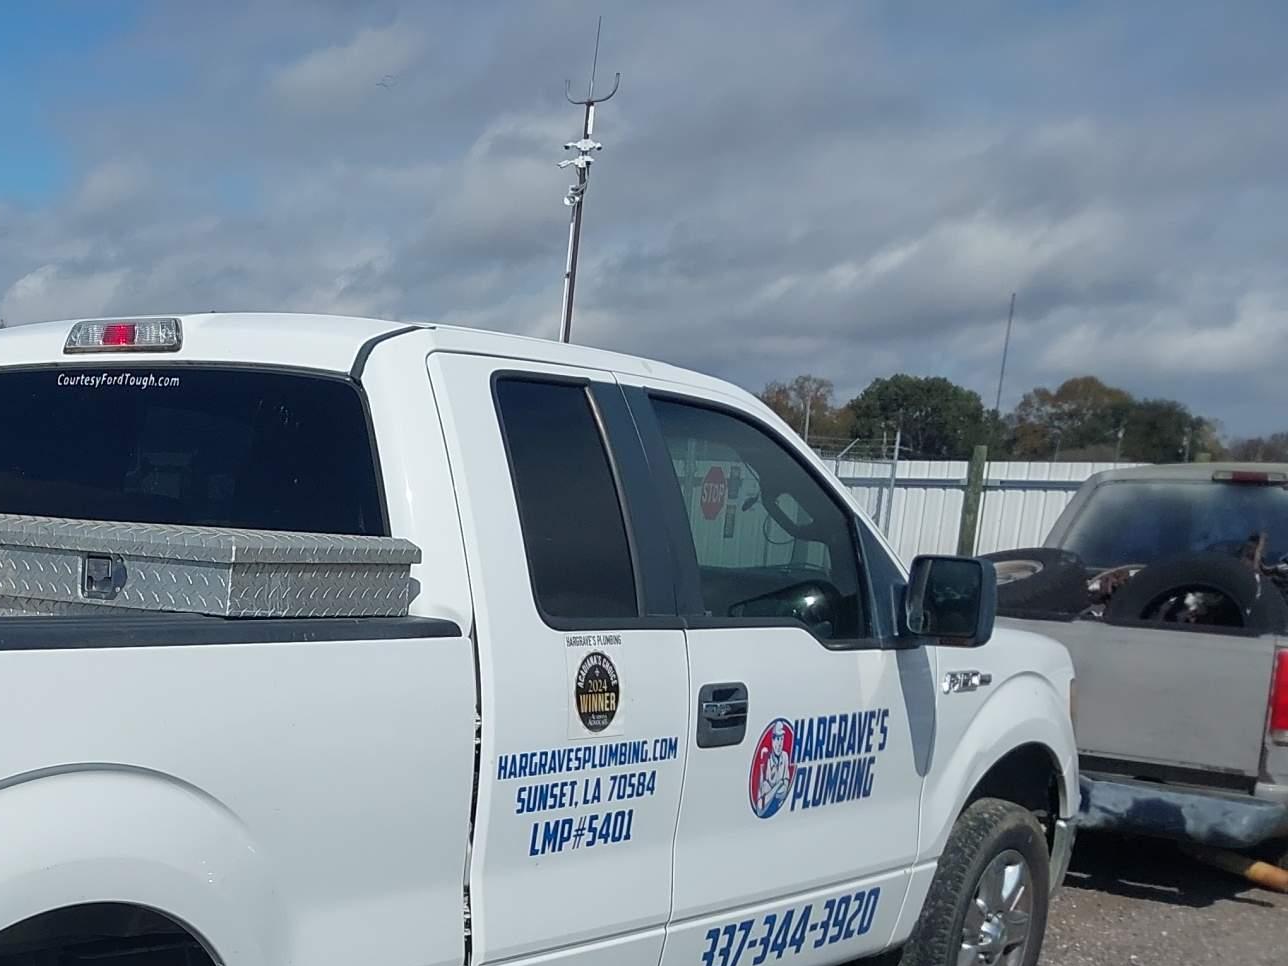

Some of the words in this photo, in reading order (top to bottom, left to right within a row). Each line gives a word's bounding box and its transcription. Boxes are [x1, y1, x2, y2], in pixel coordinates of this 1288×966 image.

[57, 373, 180, 389] CourtesyFordTough.com
[702, 482, 725, 503] STOP
[566, 635, 596, 647] HARGRAVE'S
[597, 634, 622, 646] PLUMBING
[577, 654, 602, 689] ACADIANA'S
[602, 658, 618, 687] CHOICE
[588, 680, 608, 693] 2024
[579, 692, 616, 713] WINNER
[794, 709, 889, 764] HARGRAVE'S
[497, 737, 679, 780] HARGRAVESPLUMBING.COM
[515, 781, 580, 815] SUNSET,
[582, 780, 601, 804] LA
[608, 770, 657, 802] 70584
[790, 757, 874, 812] PLUMBING
[528, 809, 634, 858] LMP#5401
